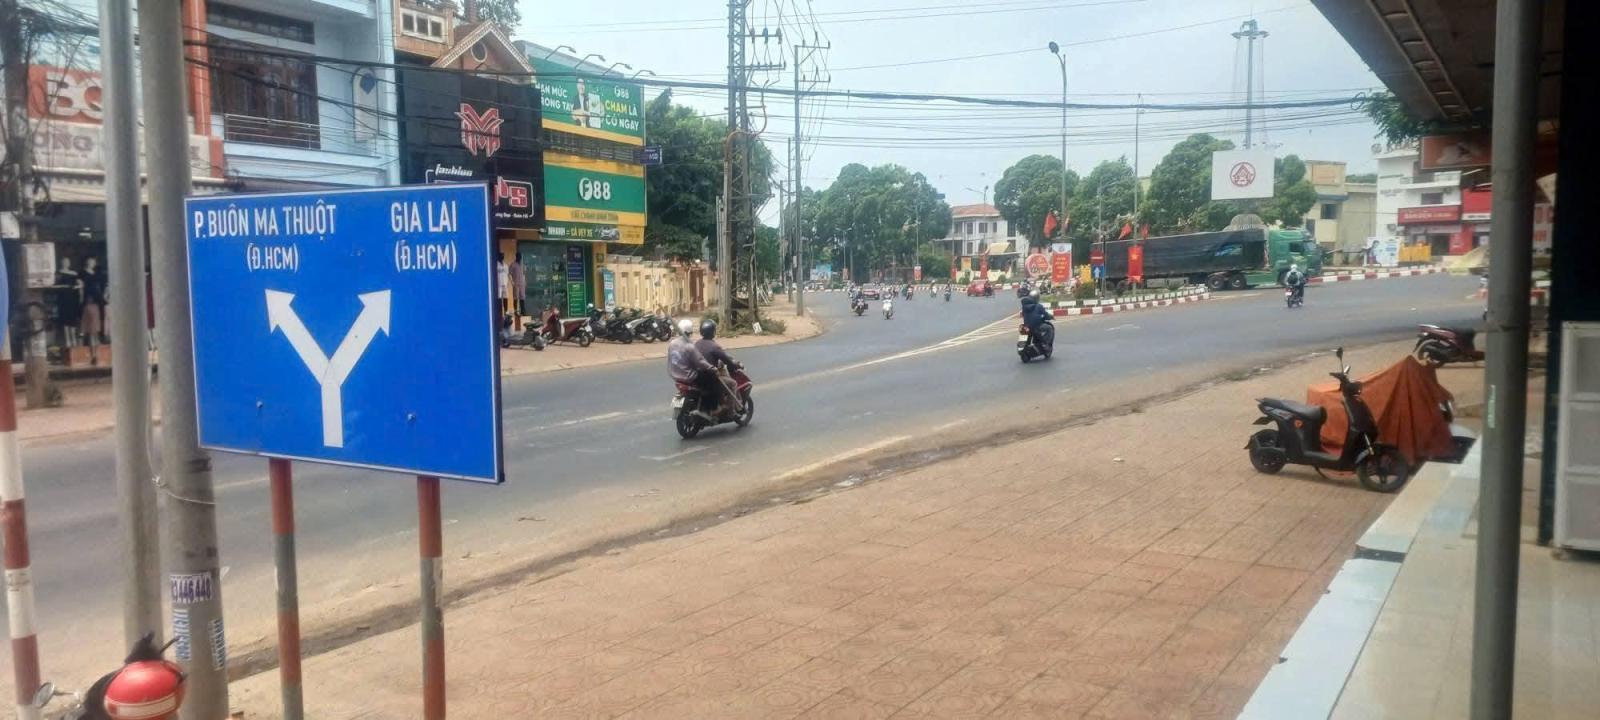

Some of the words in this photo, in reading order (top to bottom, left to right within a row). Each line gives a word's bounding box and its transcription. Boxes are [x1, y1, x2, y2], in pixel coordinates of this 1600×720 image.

[541, 97, 561, 110] RONG
[551, 84, 568, 98] MỨC
[605, 114, 618, 127] CÓ
[619, 119, 640, 132] NGAY
[579, 177, 612, 201] F88
[254, 207, 279, 236] MA
[282, 198, 337, 241] THUỘT
[390, 201, 423, 233] GIA
[427, 200, 457, 233] LAI
[246, 242, 299, 273] (Đ.HCM)
[394, 239, 457, 273] (Đ.HCM)
